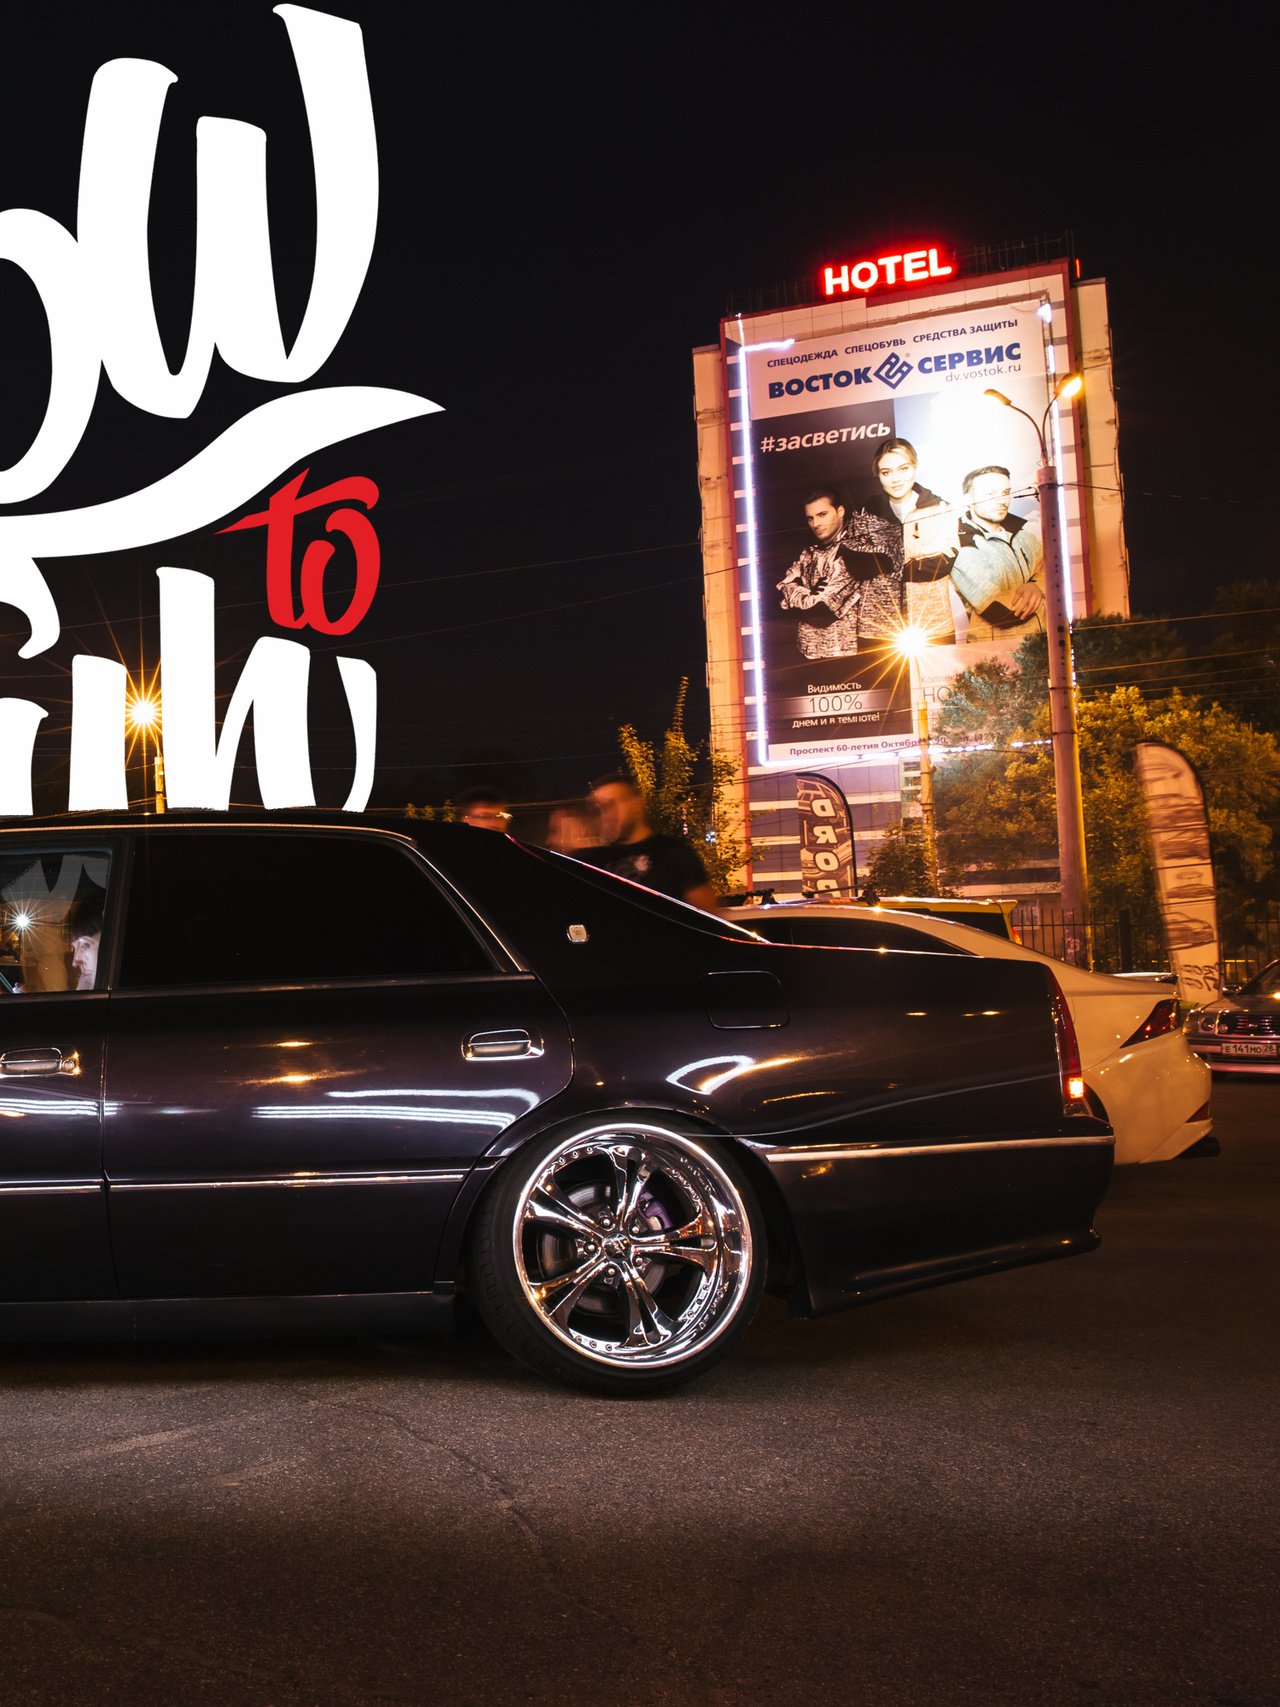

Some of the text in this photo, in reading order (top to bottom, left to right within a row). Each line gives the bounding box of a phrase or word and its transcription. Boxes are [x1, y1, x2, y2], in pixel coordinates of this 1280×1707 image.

[824, 248, 952, 295] HOTEL
[767, 319, 1018, 368] СПЕЦОДЕЖДА СПЕЦОБУВЬ СРЕДСТВА ЗАЩИТЫ
[768, 343, 1022, 399] ВОСТОК СЕРВИС
[945, 363, 1022, 383] dv.vostok.ru
[760, 422, 891, 453] #засветись
[807, 682, 862, 694] Видимость
[921, 674, 956, 685] Коллек
[809, 694, 862, 713] 100%
[923, 686, 951, 702] НО
[792, 719, 818, 729] днем
[820, 718, 827, 726] и
[838, 712, 880, 724] темноте!
[790, 747, 834, 756] Проспект
[836, 743, 879, 752] 60-летия
